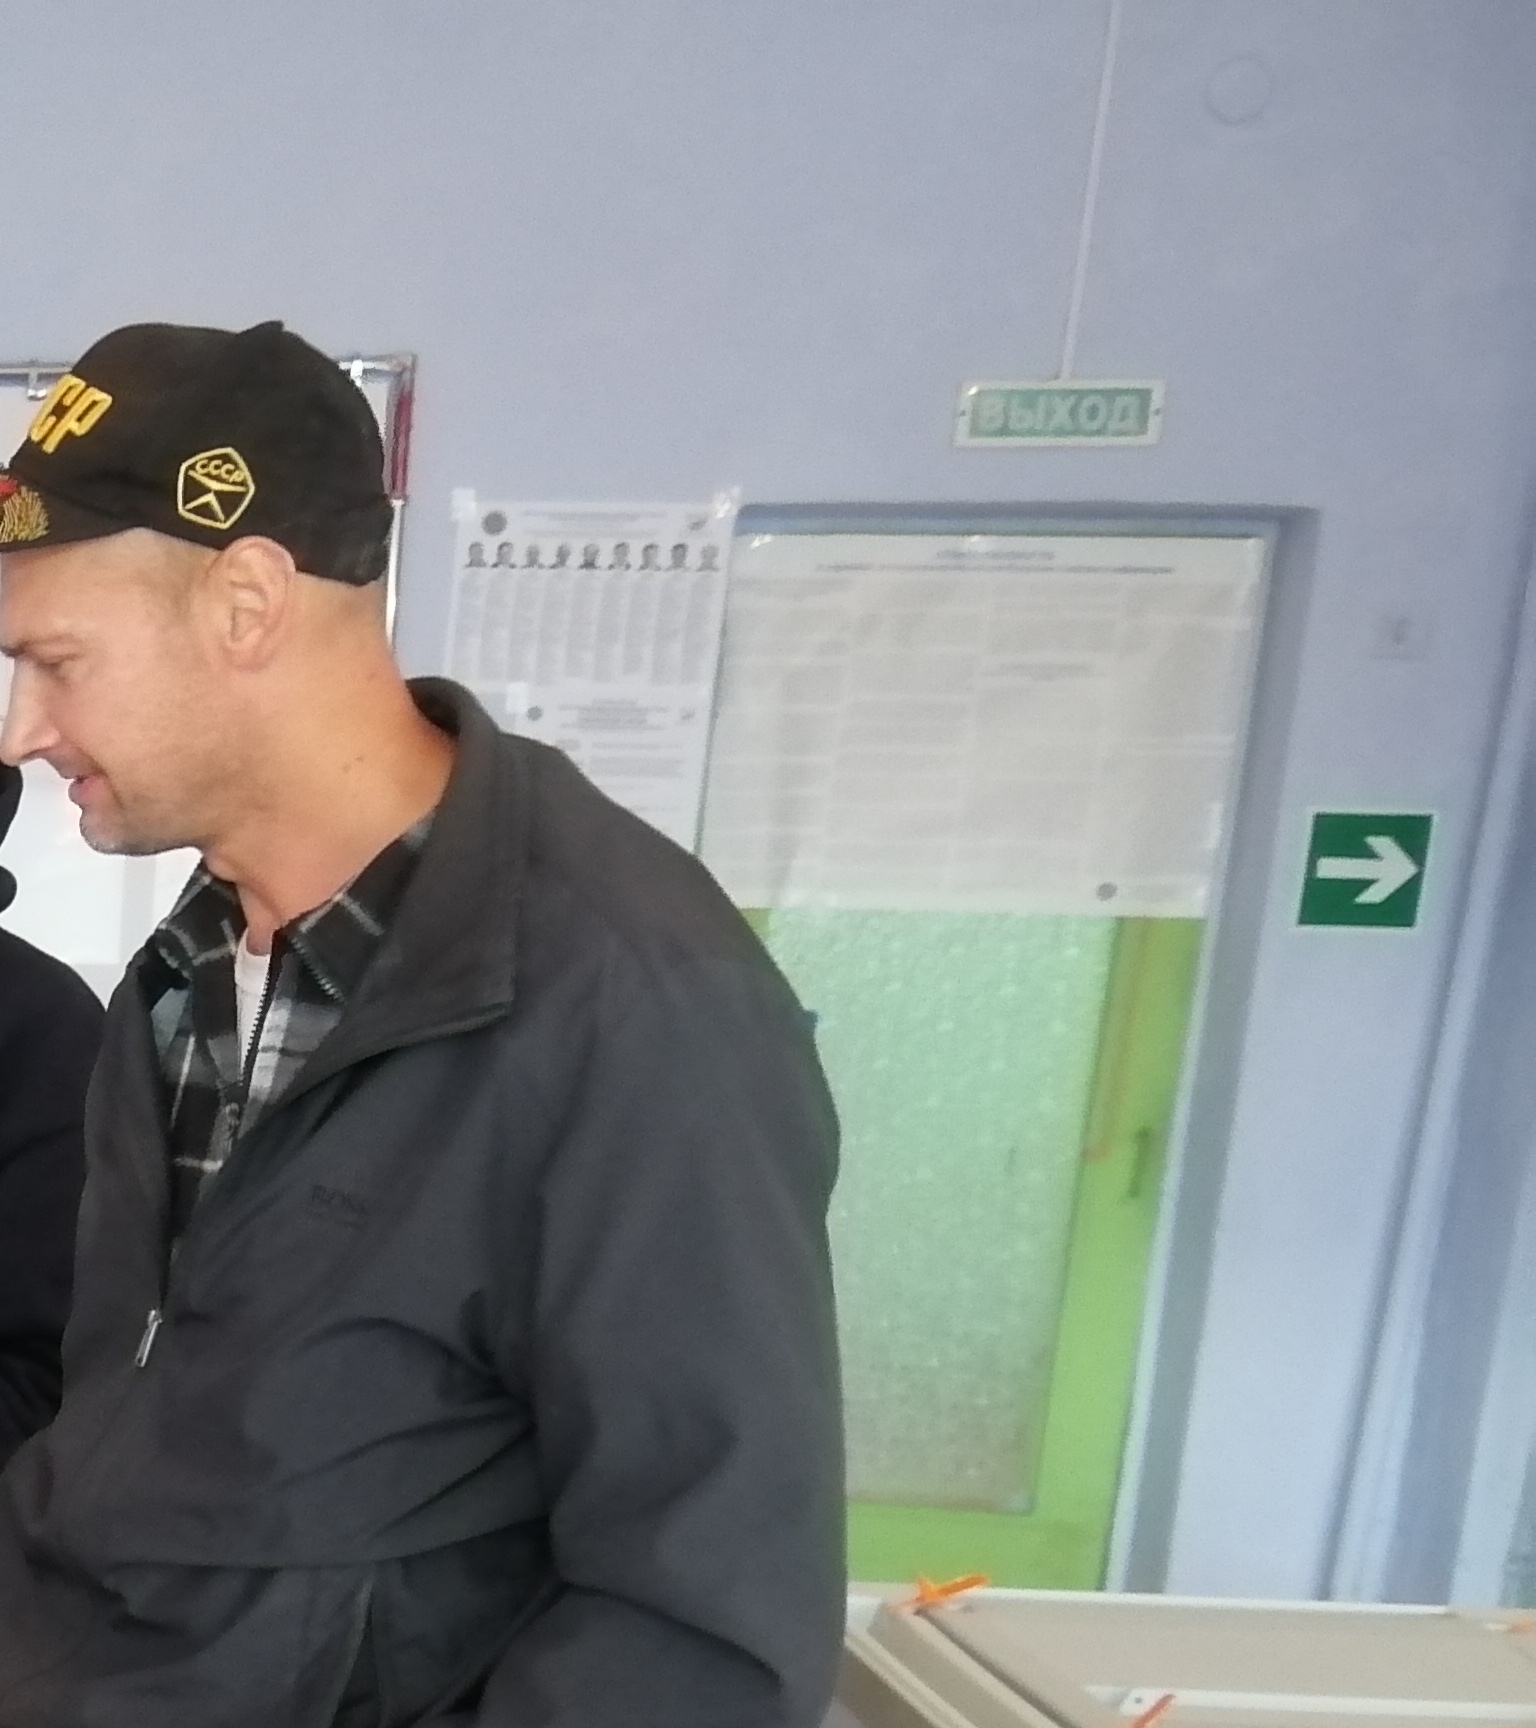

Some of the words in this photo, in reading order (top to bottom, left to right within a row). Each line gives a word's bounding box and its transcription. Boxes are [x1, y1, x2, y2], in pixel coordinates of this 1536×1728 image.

[30, 373, 113, 453] СР
[981, 392, 1142, 436] ВЫХОД
[194, 459, 247, 483] СССР
